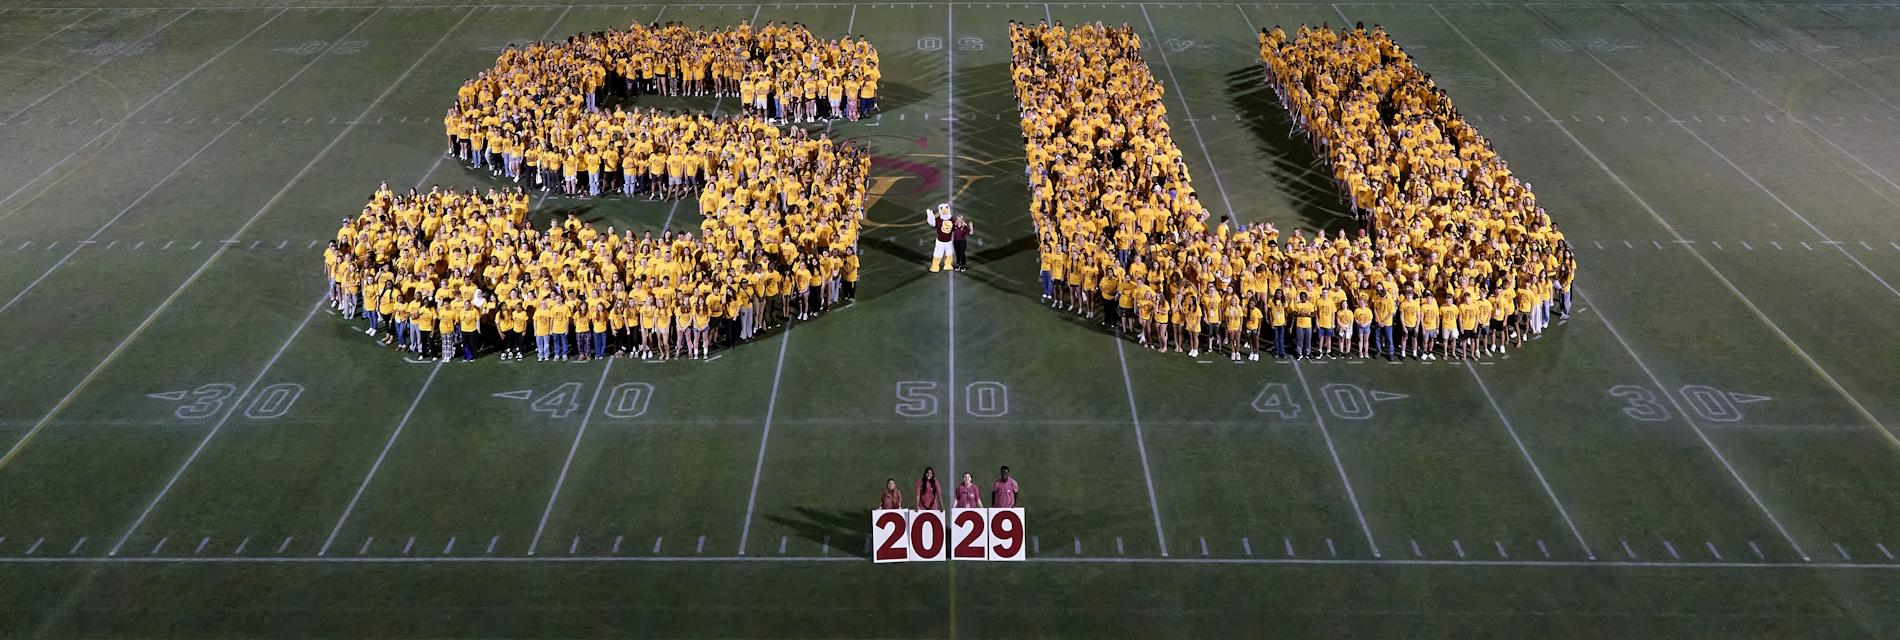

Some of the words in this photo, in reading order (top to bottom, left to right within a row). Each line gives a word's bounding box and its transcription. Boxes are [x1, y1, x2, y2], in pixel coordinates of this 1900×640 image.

[175, 383, 304, 420] 30
[531, 382, 654, 418] 40
[895, 381, 1008, 417] 50
[1251, 382, 1374, 419] 40
[1609, 384, 1743, 422] 30
[876, 510, 1024, 561] 2029
